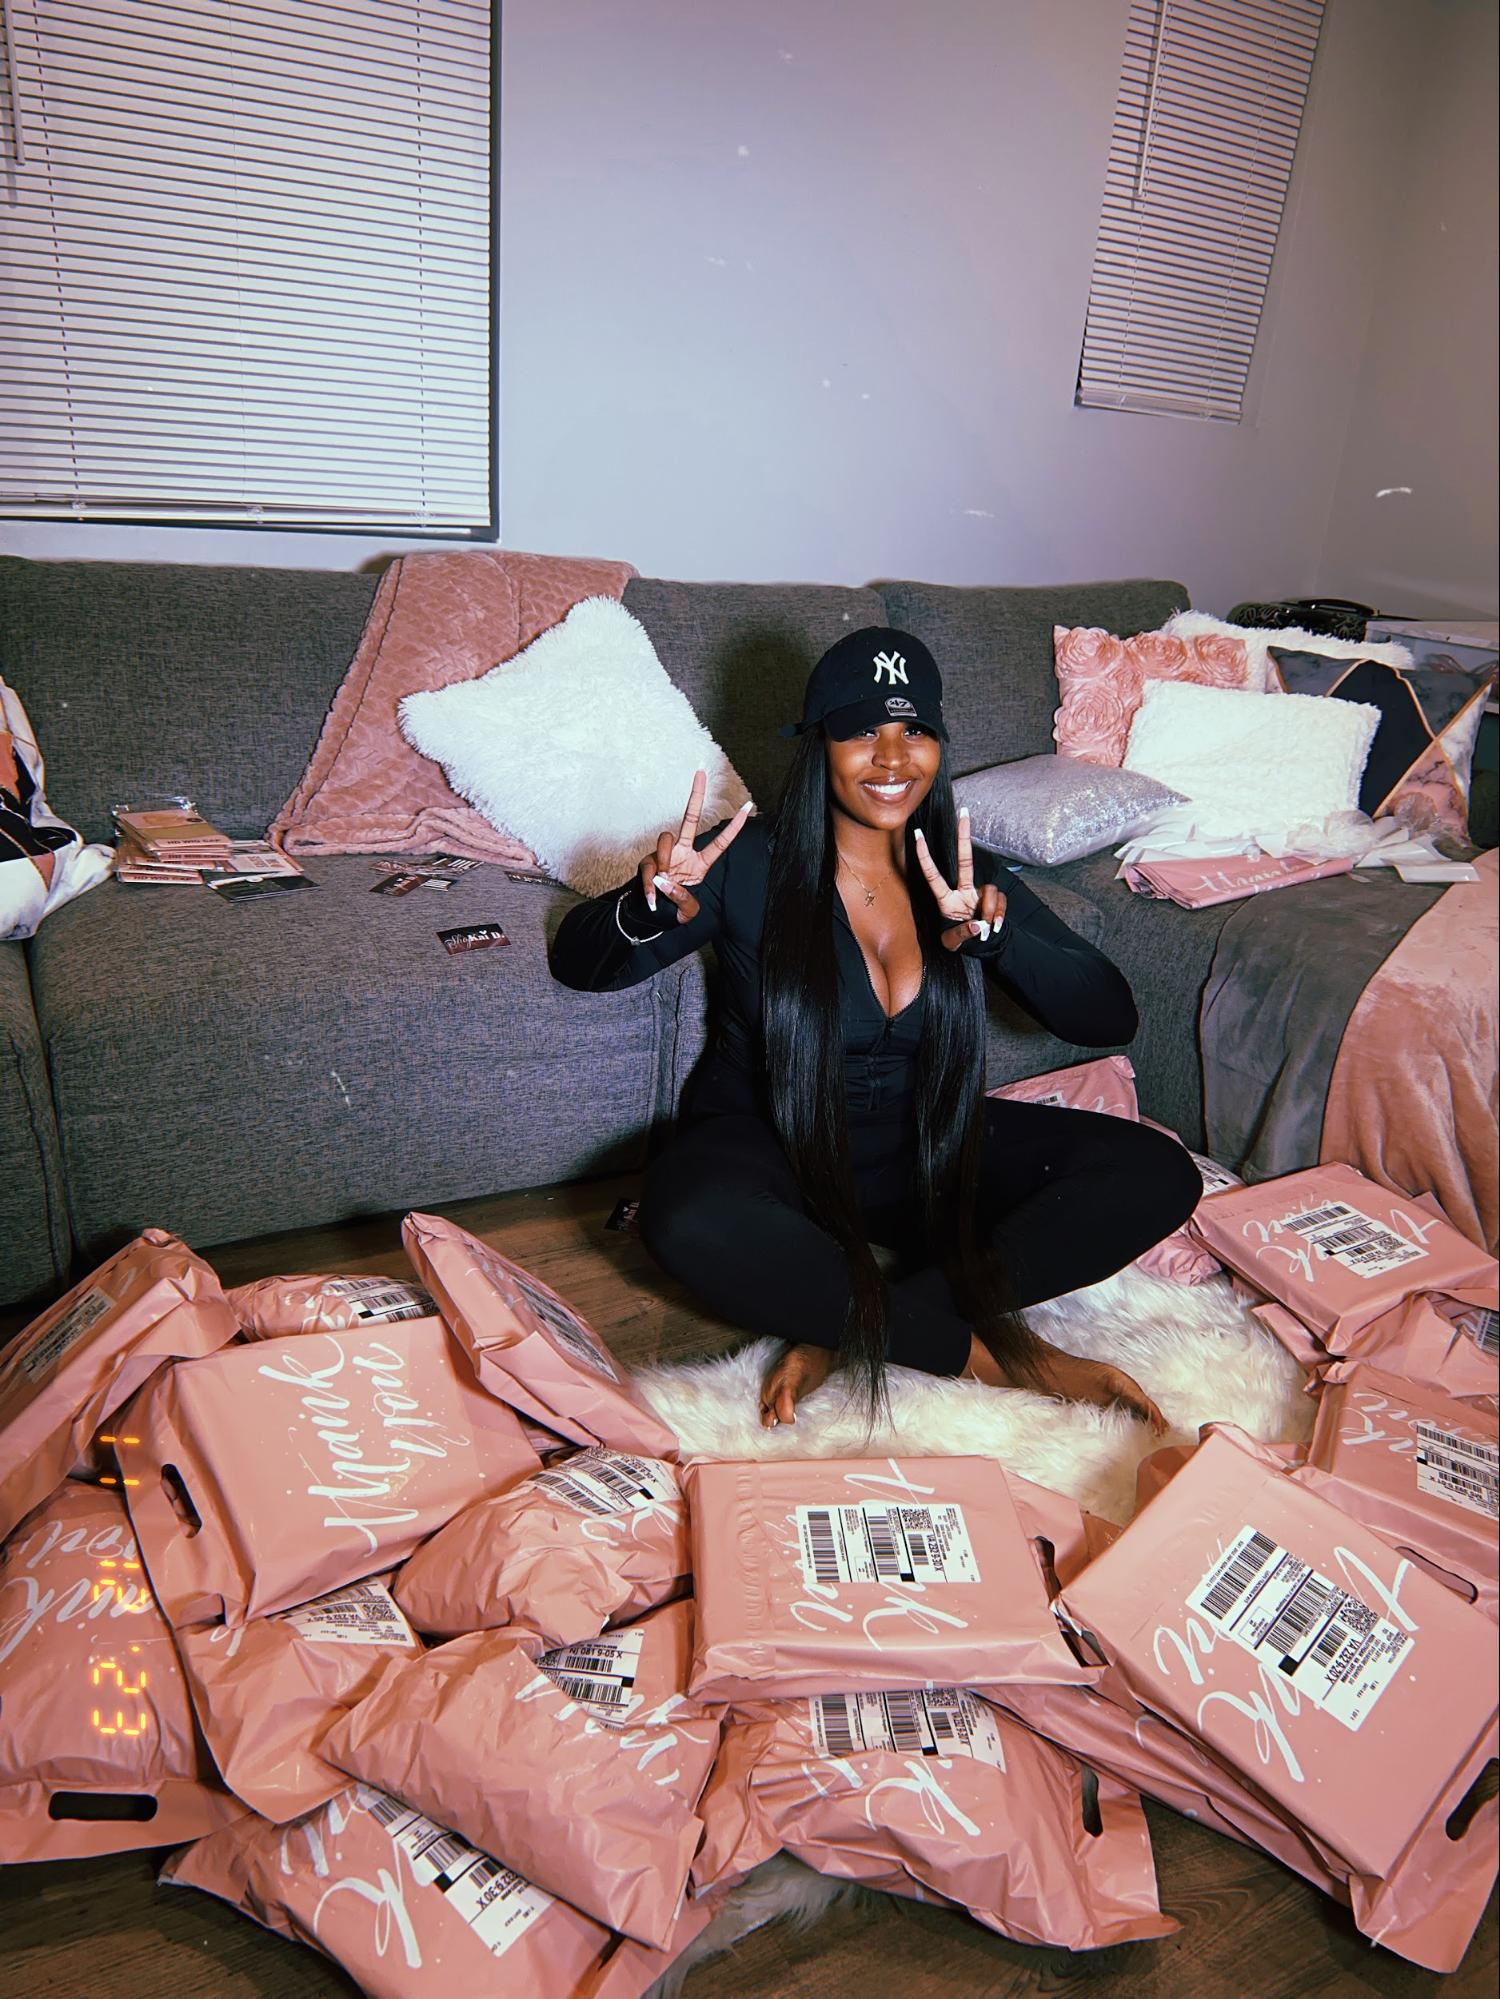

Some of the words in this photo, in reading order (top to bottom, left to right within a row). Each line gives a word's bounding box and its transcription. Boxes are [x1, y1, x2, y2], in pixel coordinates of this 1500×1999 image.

[873, 651, 910, 685] NY
[1346, 1636, 1362, 1652] VA
[1337, 1646, 1355, 1664] 232
[1327, 1658, 1346, 1679] 9-20
[1323, 1673, 1336, 1685] X
